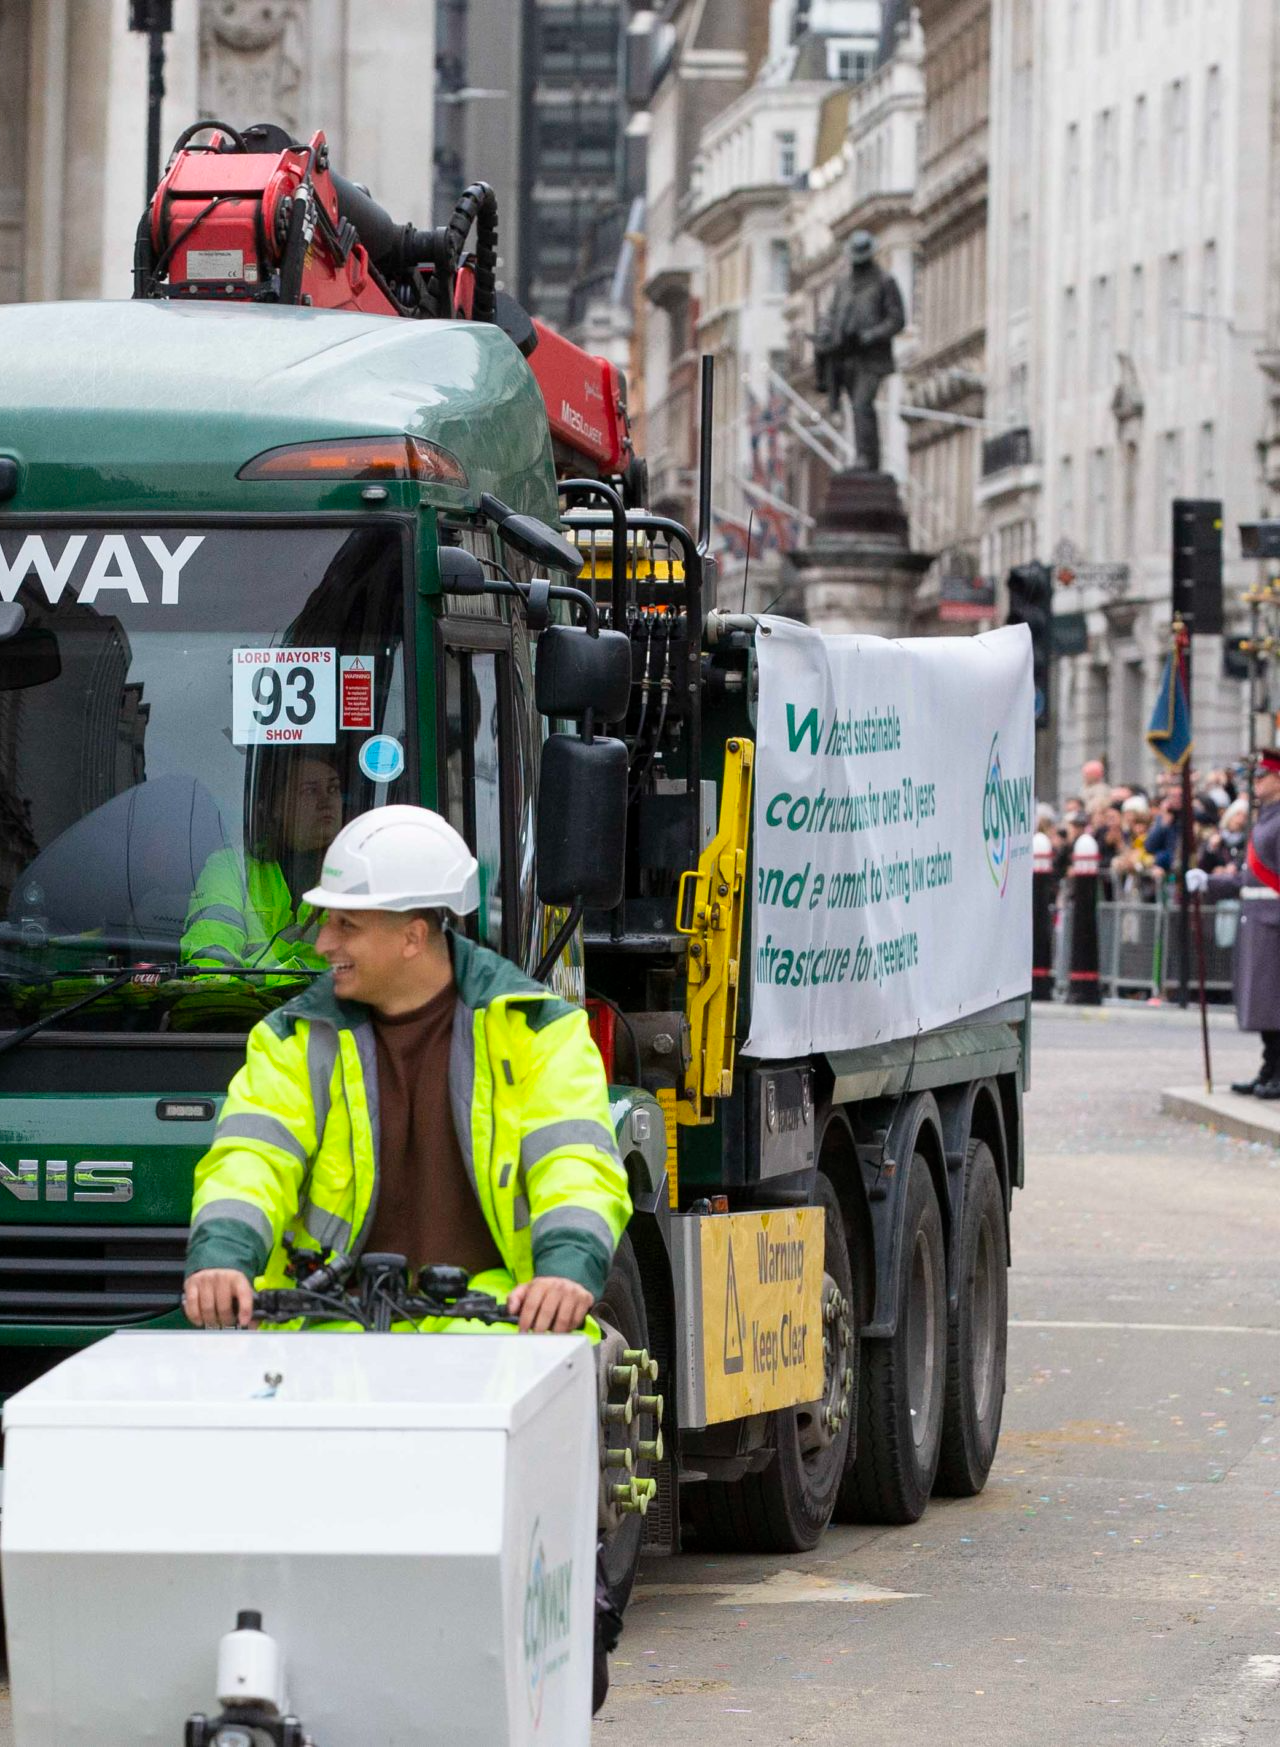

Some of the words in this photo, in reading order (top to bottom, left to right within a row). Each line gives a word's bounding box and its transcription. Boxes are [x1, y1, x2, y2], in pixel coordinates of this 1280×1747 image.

[237, 652, 270, 664] LORD
[275, 651, 331, 663] MAYOR'S
[251, 666, 316, 725] 93
[266, 729, 303, 741] SHOW
[854, 705, 901, 755] sustainable
[882, 788, 900, 825] over
[902, 777, 913, 822] 30
[914, 782, 936, 829] years
[983, 775, 1032, 841] CONWAY
[871, 860, 882, 903] to
[911, 847, 925, 892] low
[926, 842, 953, 889] carbon
[850, 935, 873, 983] for
[756, 1224, 804, 1295] Warning
[752, 1320, 778, 1386] Keep
[780, 1310, 807, 1369] Clear
[523, 1559, 573, 1661] CONWAY
